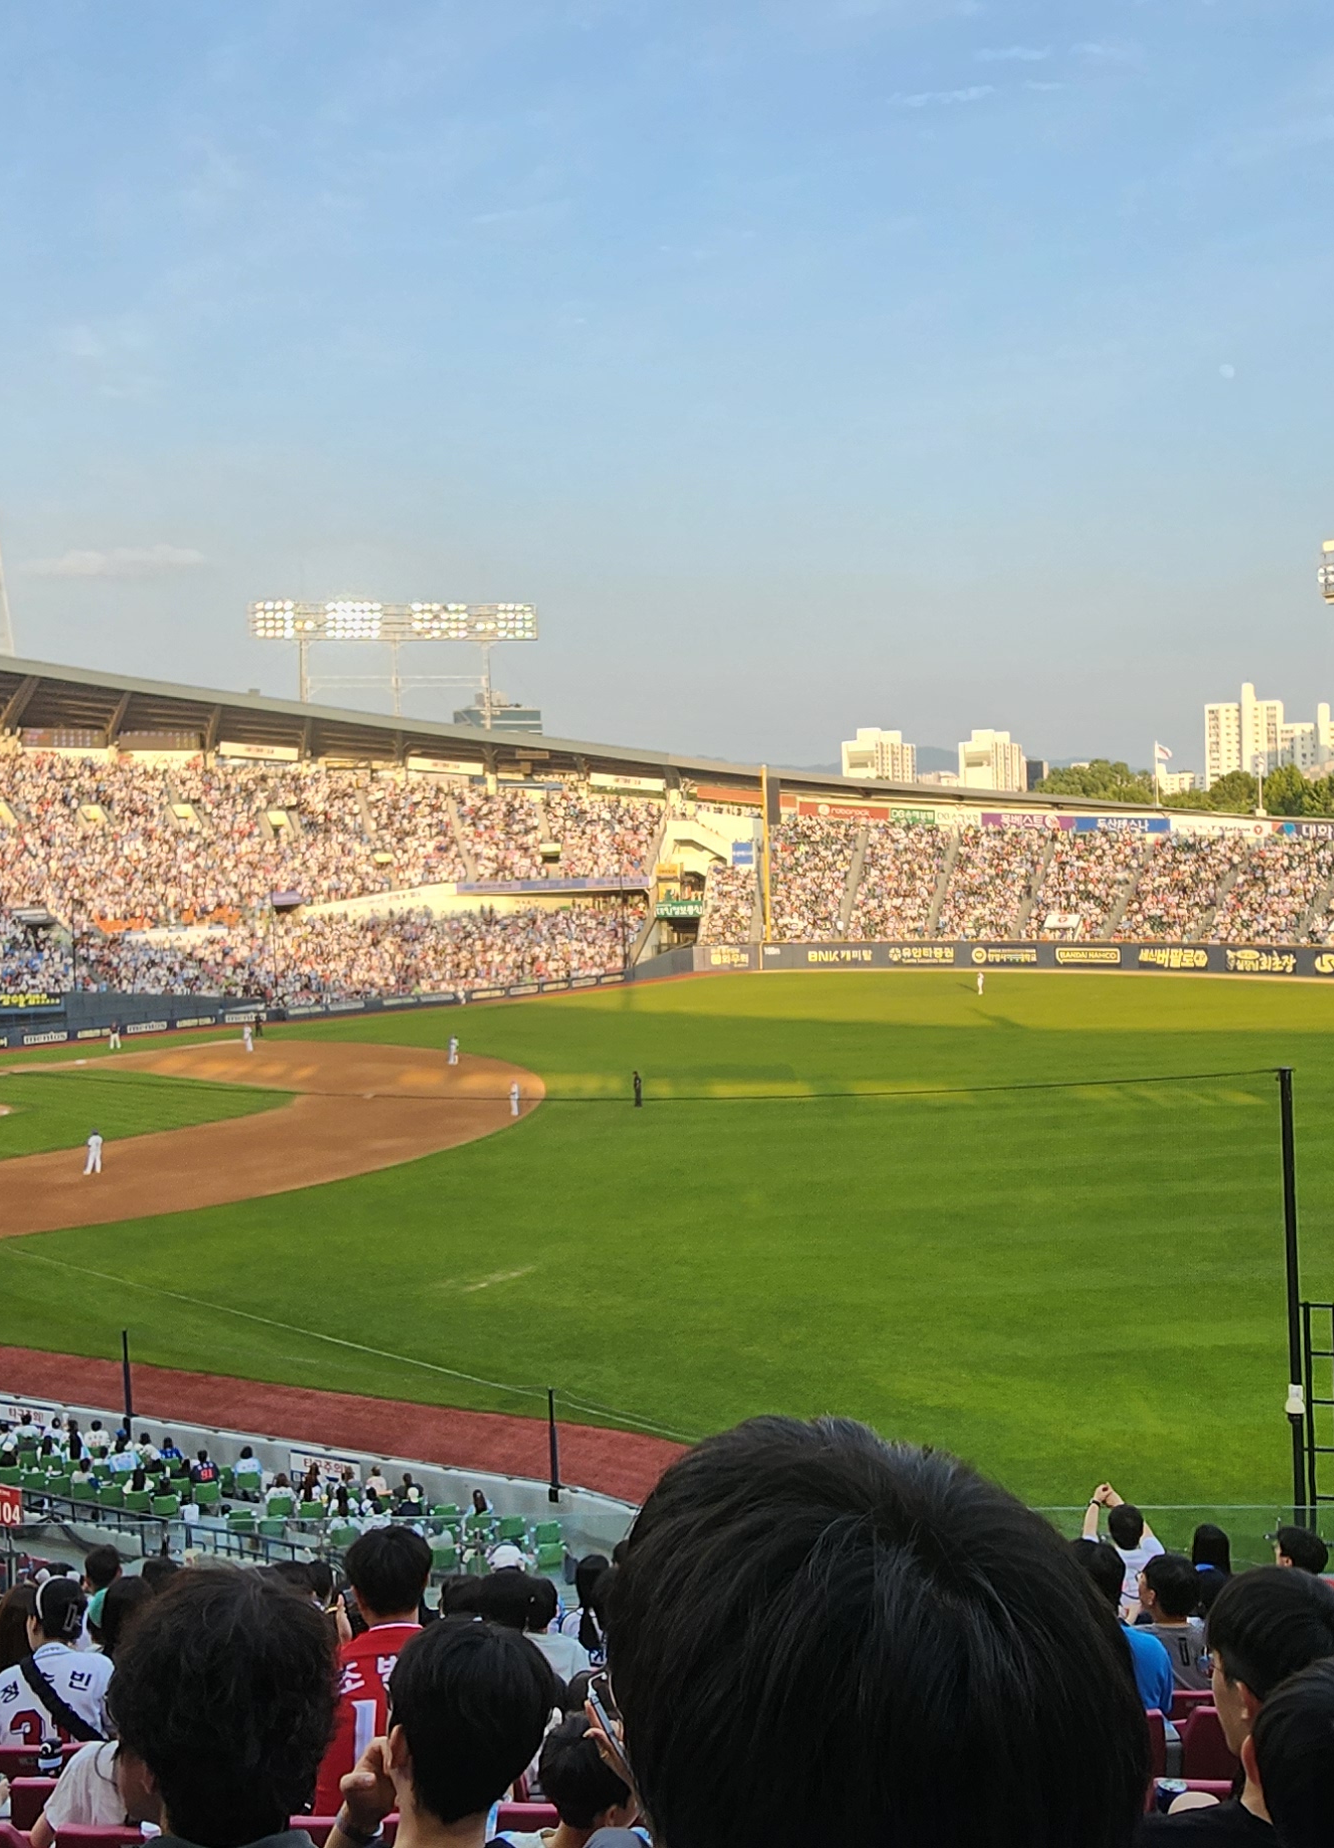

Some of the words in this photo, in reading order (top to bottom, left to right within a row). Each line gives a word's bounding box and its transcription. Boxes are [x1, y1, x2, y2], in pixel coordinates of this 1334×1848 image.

[1059, 951, 1085, 960] BANDAI
[1088, 951, 1116, 960] NAMCO
[127, 1021, 167, 1033] mentos
[24, 1032, 67, 1043] mentos
